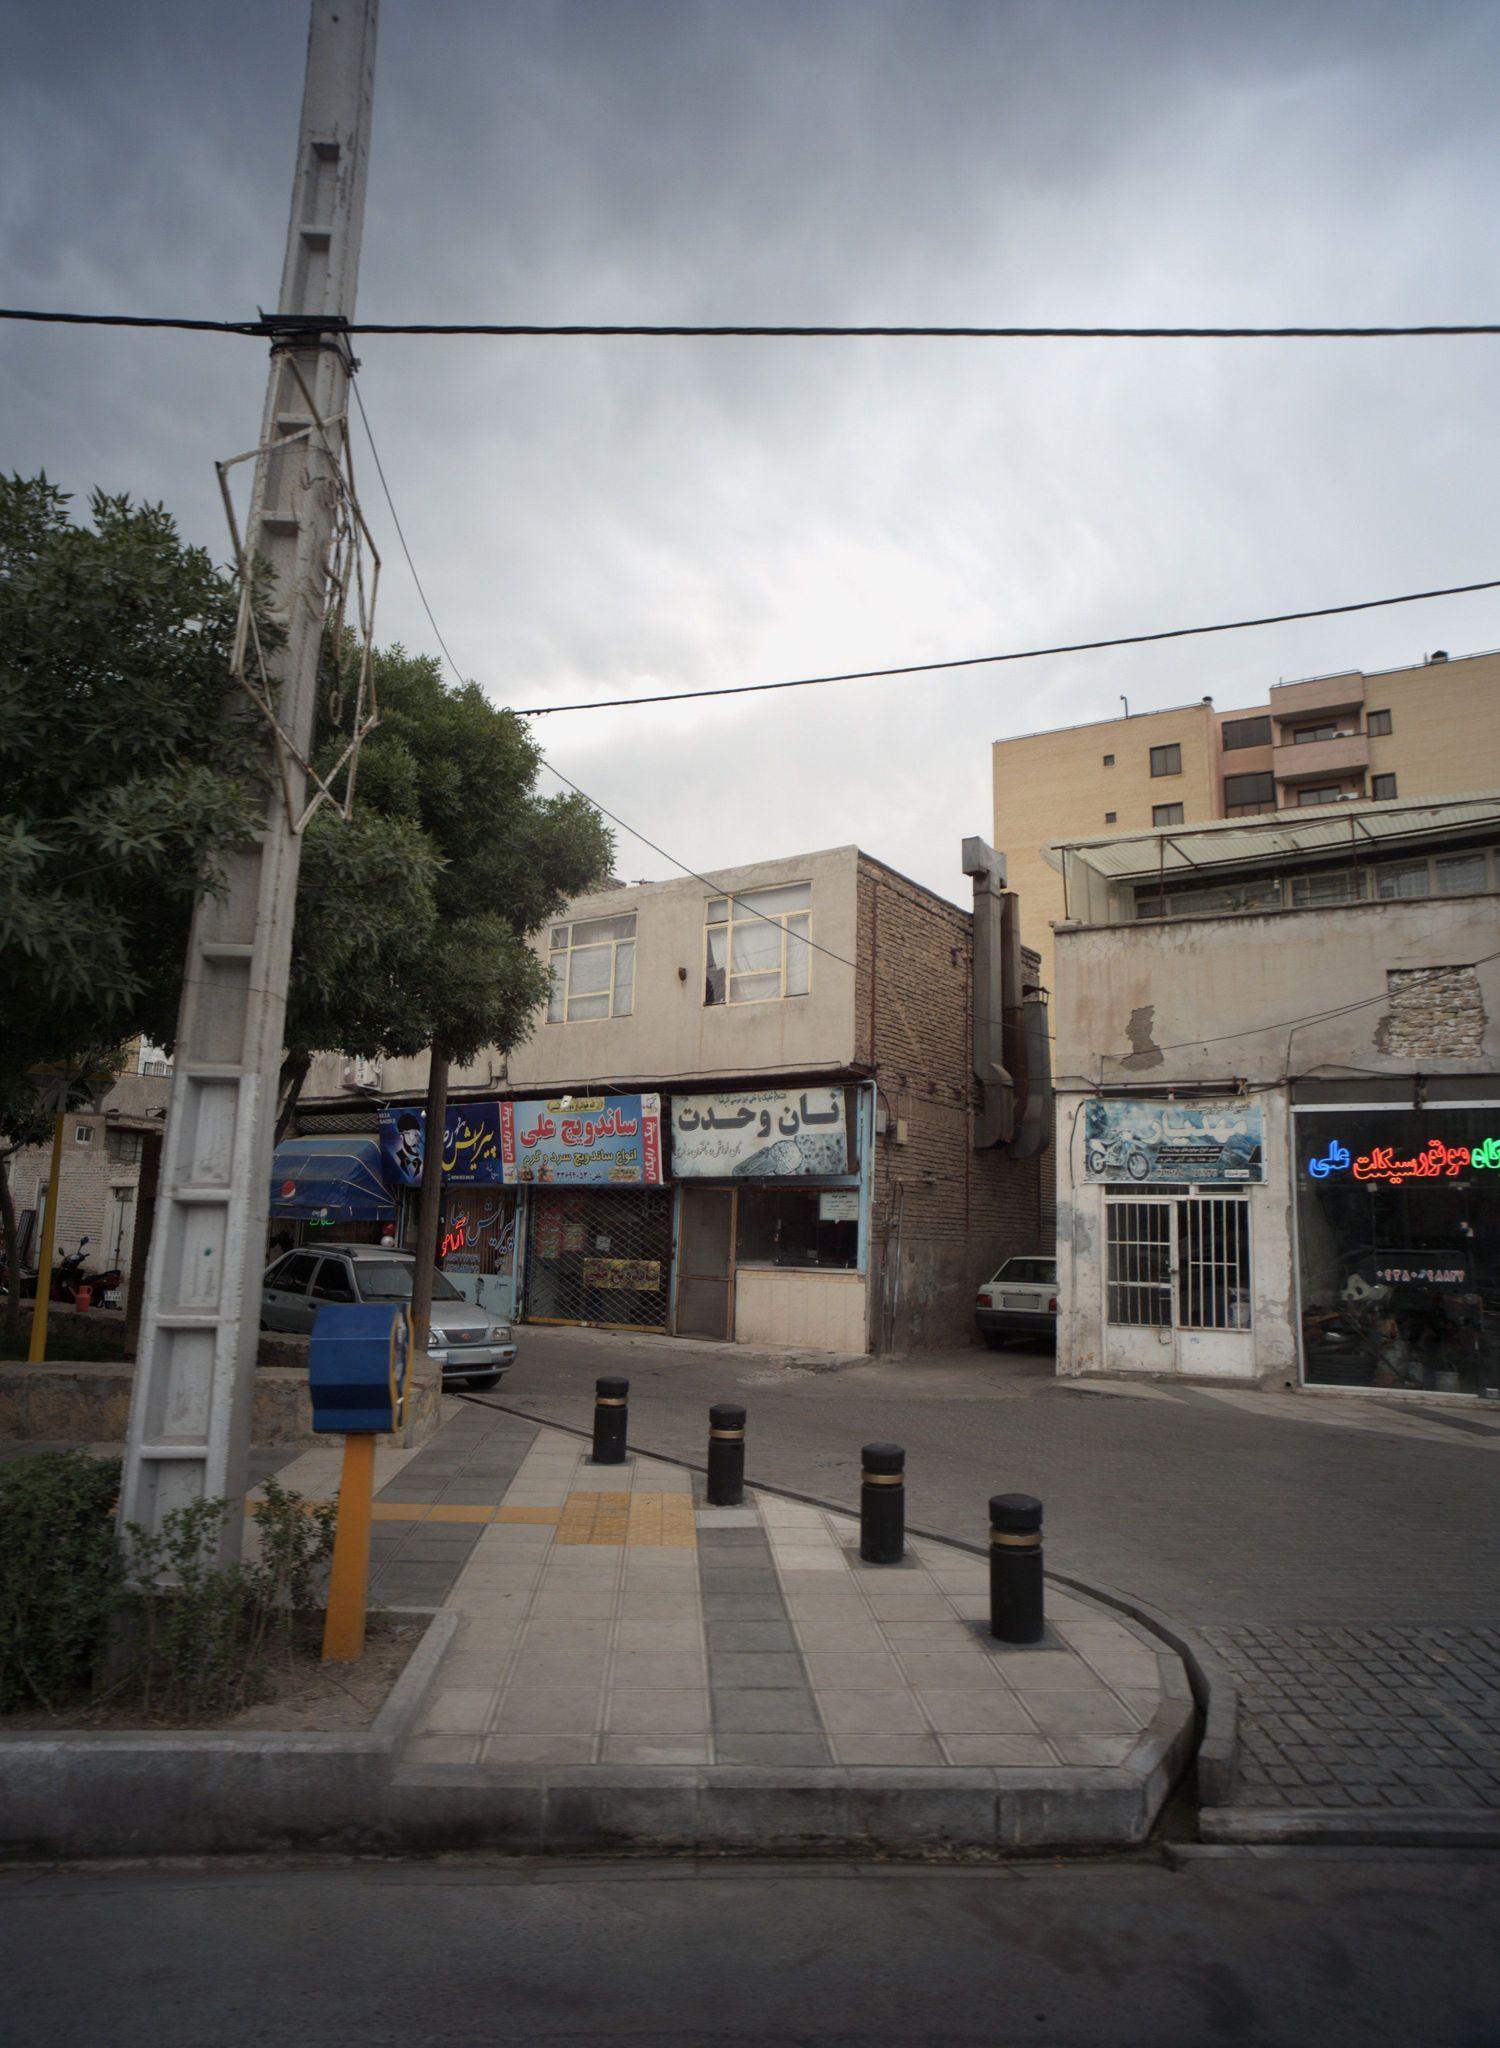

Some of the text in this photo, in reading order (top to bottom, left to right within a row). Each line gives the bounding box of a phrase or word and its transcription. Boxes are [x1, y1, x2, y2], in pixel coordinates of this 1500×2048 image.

[519, 1107, 639, 1148] ساندویچ علی
[778, 1091, 840, 1137] نان
[441, 1120, 498, 1172] پیرایش
[523, 1149, 543, 1167] گرم
[550, 1152, 573, 1166] سرد
[573, 1148, 614, 1168] ساندویچ
[615, 1148, 638, 1167] انواع
[1308, 1139, 1351, 1178] علی
